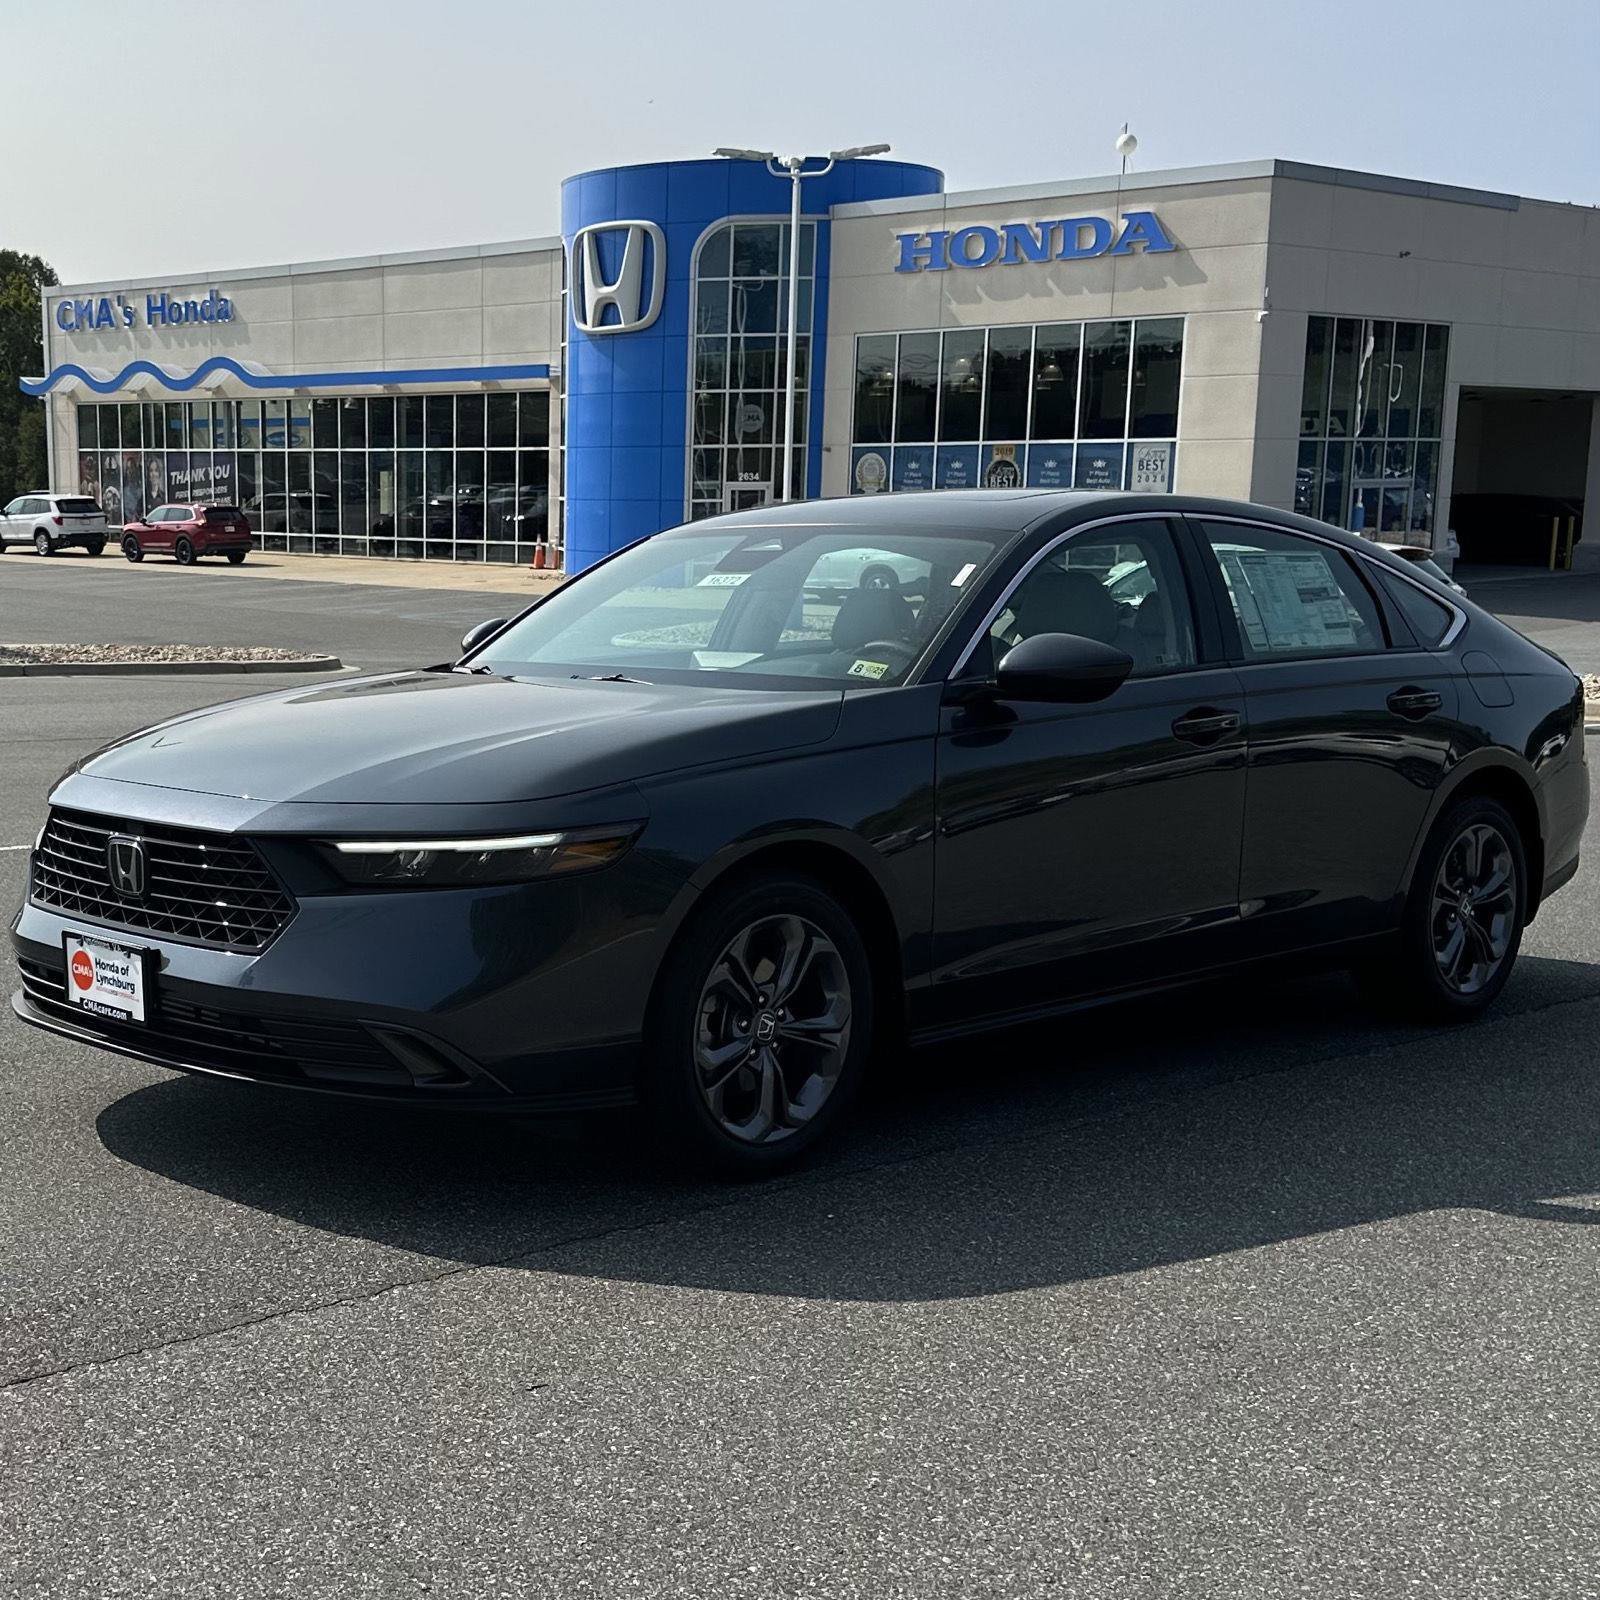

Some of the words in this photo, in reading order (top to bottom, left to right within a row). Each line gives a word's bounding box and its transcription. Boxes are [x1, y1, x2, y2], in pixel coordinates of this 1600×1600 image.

[894, 210, 1177, 273] HONDA
[56, 294, 136, 332] CMA's
[146, 288, 234, 326] Honda
[170, 467, 206, 486] THANK
[208, 464, 231, 481] YOU
[1138, 459, 1165, 472] BEST
[738, 472, 760, 481] 2634
[990, 474, 1014, 487] BEST
[1137, 474, 1165, 483] 2020
[95, 957, 120, 974] Honda
[120, 964, 130, 977] of
[96, 972, 136, 994] Lynchburg
